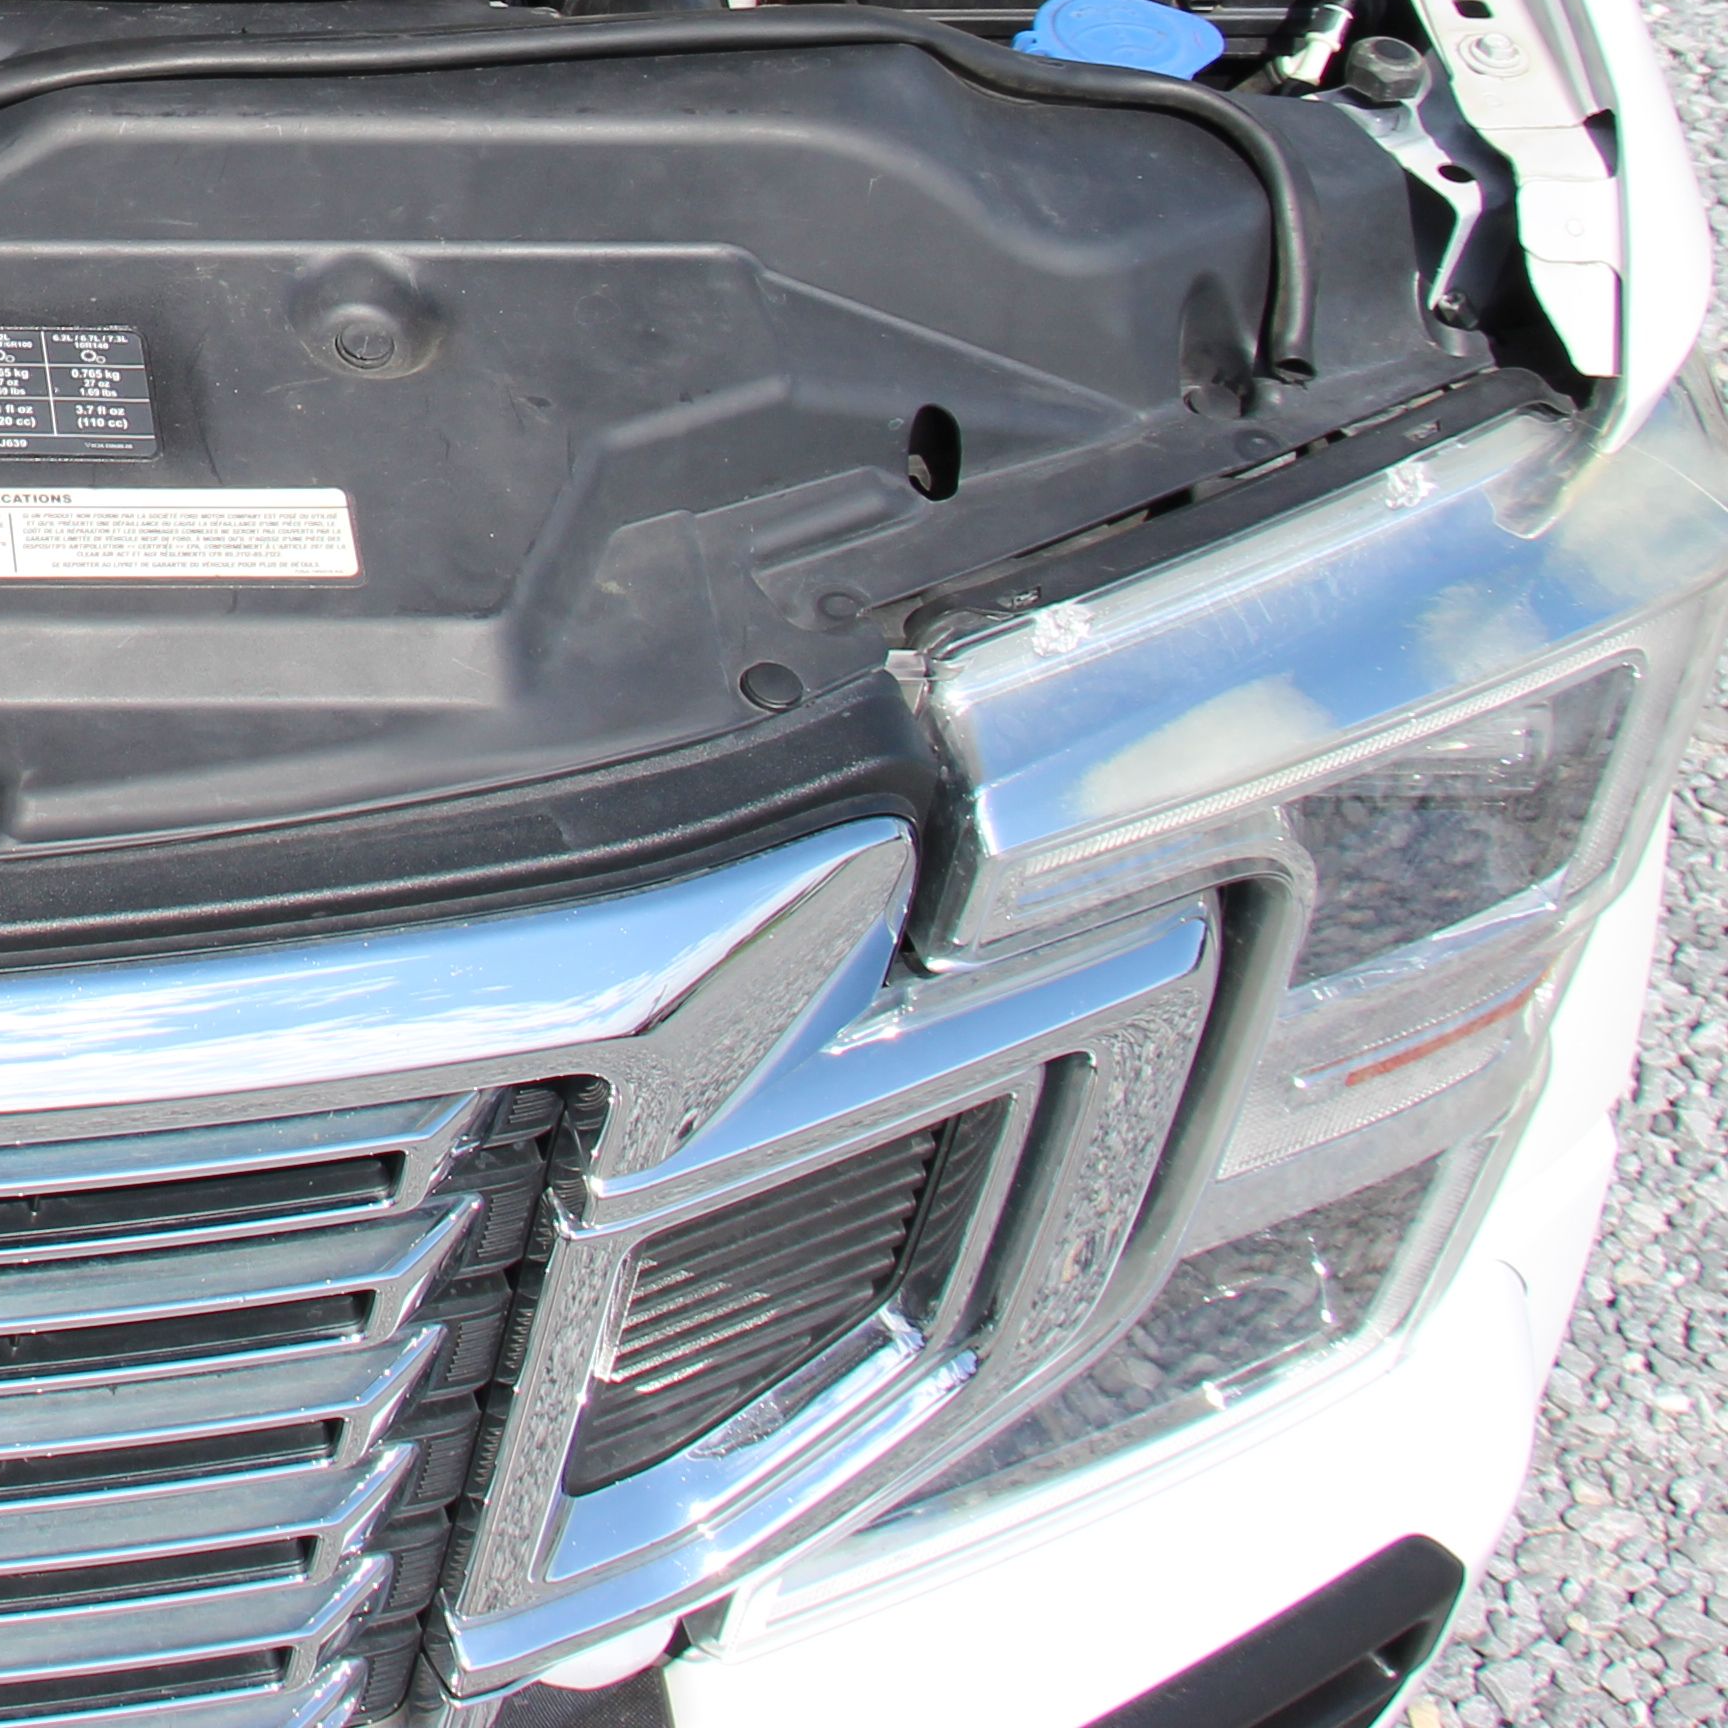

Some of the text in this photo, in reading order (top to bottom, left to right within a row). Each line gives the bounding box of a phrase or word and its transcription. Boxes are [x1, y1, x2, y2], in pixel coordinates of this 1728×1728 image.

[52, 334, 74, 342] 6.2L
[107, 335, 128, 343] 7.3L
[13, 367, 29, 380] kg
[71, 368, 120, 382] 0.765 kg
[6, 379, 19, 387] oz
[84, 379, 110, 388] 27 oz
[10, 387, 26, 395] lbs
[79, 388, 118, 397] 1.69 lbs
[5, 404, 15, 414] fl
[17, 406, 33, 414] oz
[75, 405, 94, 415] 3.7
[97, 405, 106, 415] fl
[15, 416, 36, 428] cc)
[77, 417, 128, 430] (110 cc)
